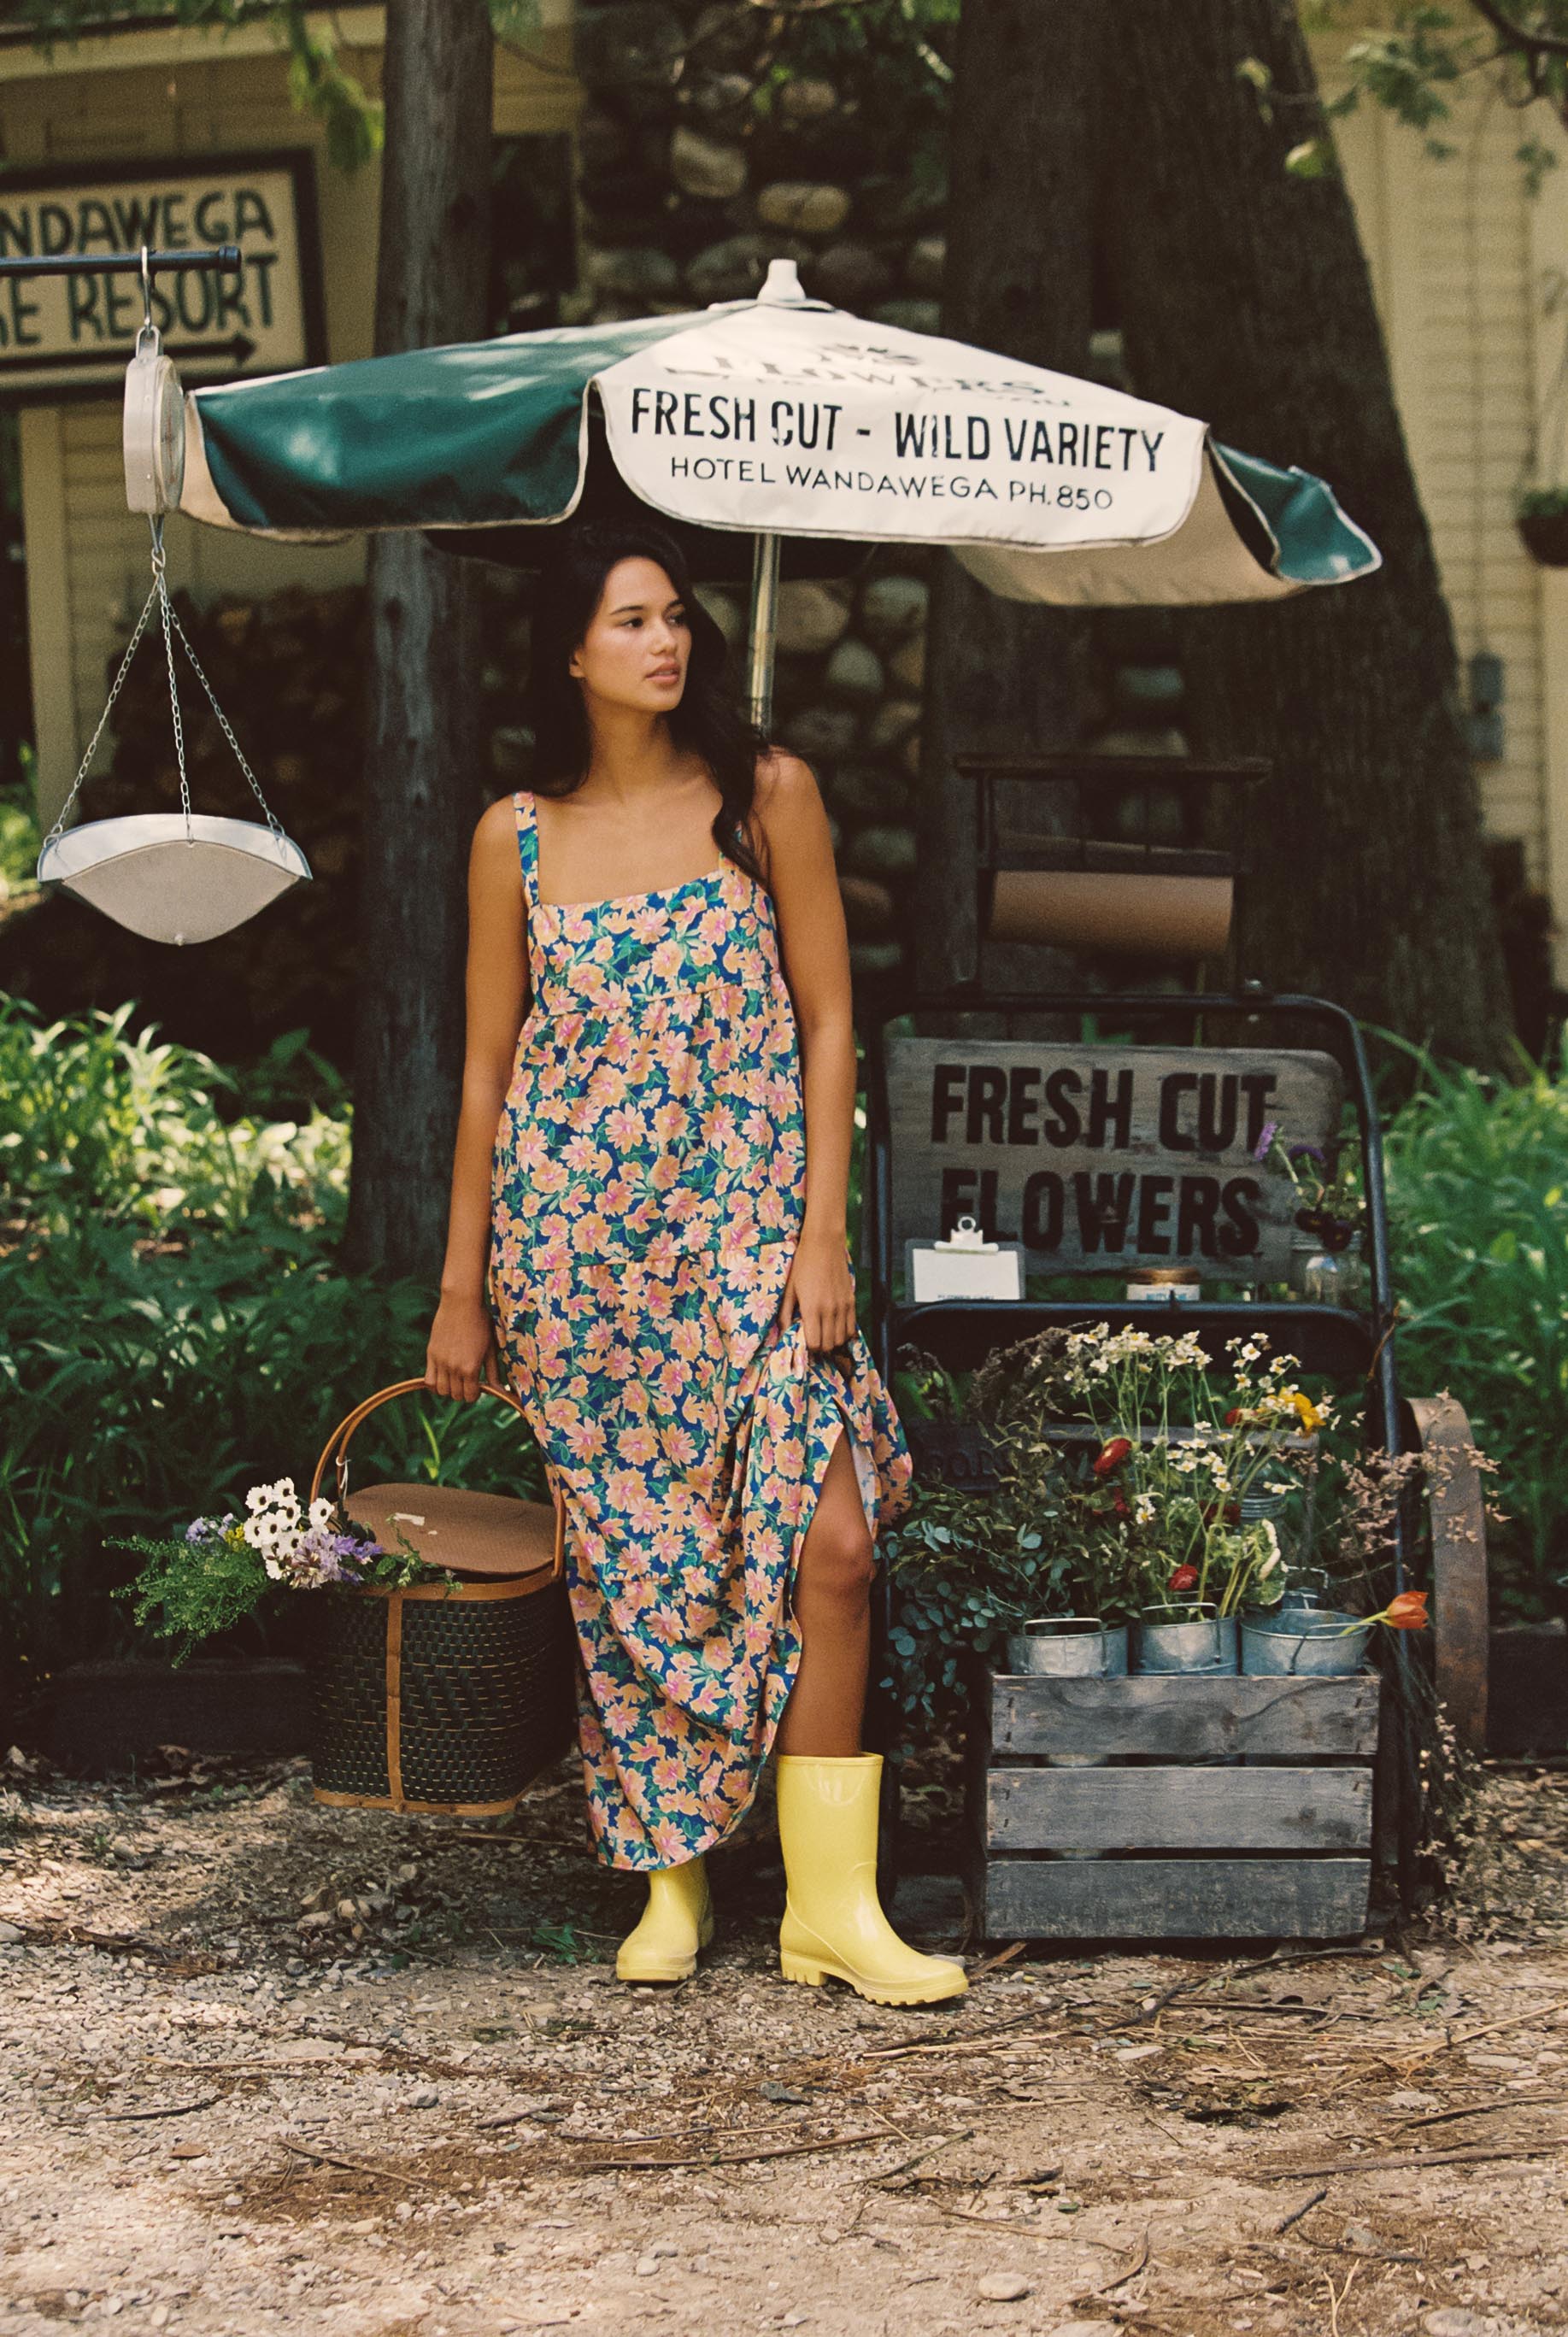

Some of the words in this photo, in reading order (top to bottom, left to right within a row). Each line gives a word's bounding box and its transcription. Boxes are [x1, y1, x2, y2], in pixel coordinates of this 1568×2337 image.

[631, 387, 755, 442] FRESH
[771, 400, 843, 451] CUT
[895, 411, 990, 461] WILD
[1003, 416, 1165, 473] VARIETY
[671, 456, 777, 484] HOTEL
[785, 464, 998, 500] WANDAWEGA
[931, 1064, 1134, 1148] FRESH
[1158, 1072, 1277, 1153] CUT
[942, 1168, 1262, 1258] FLOWERS
